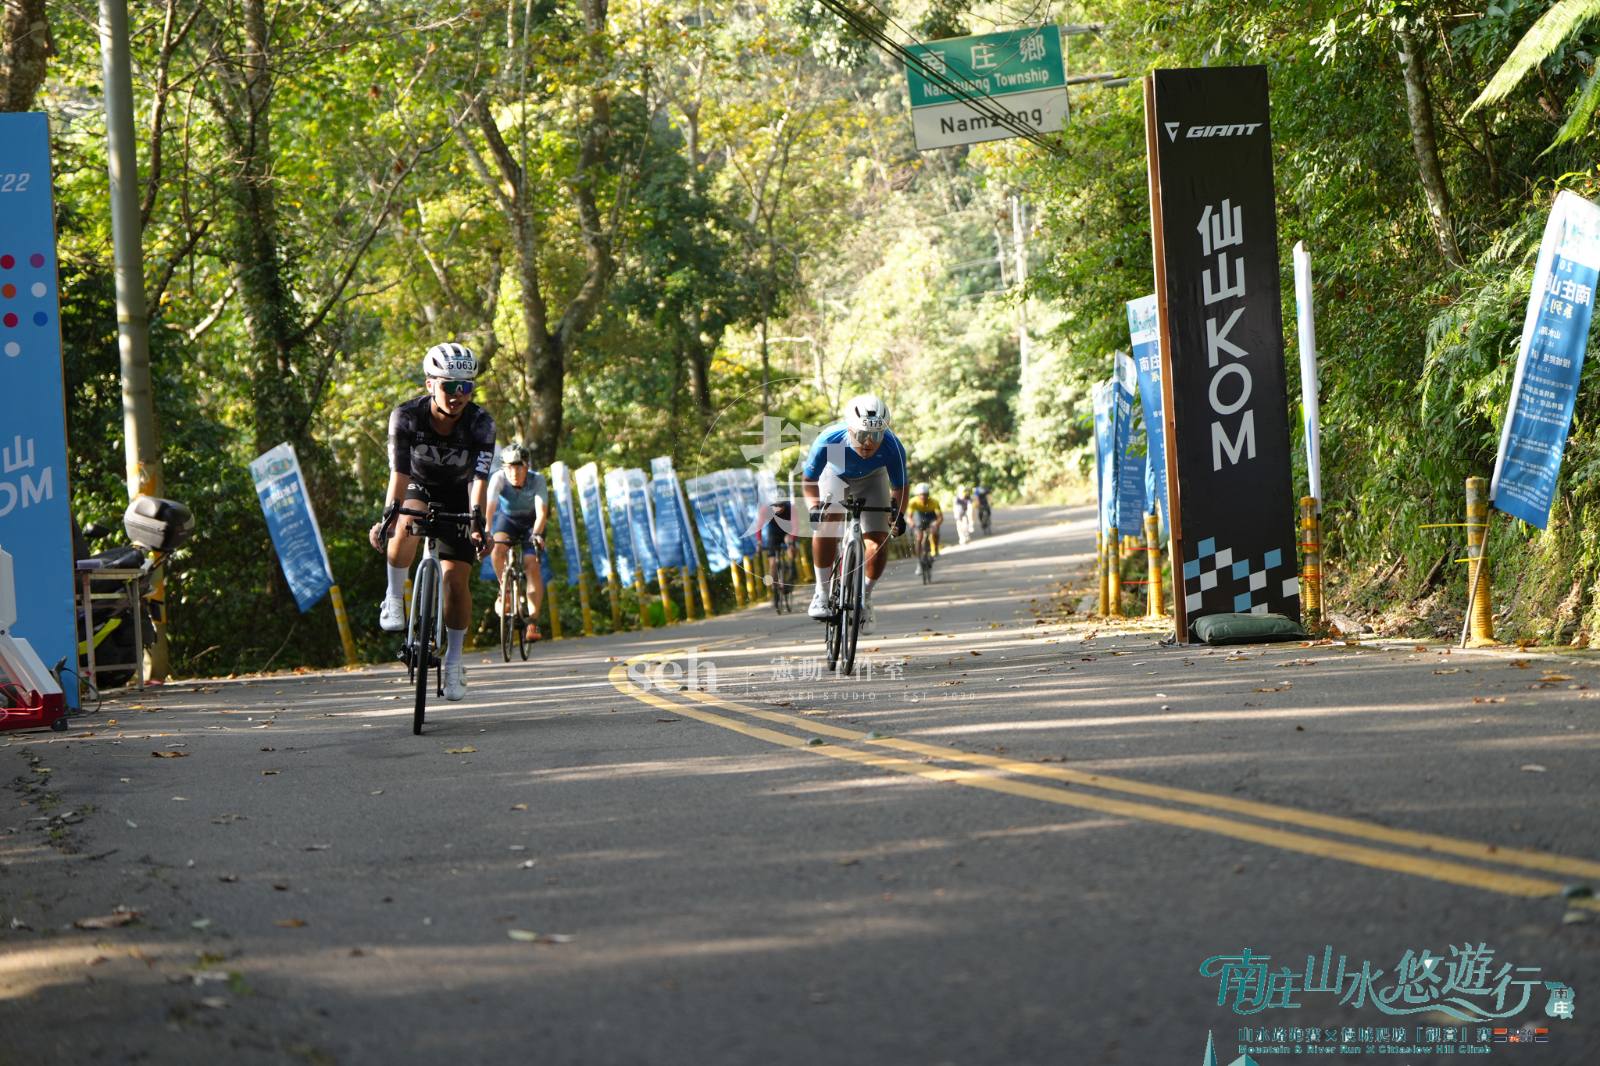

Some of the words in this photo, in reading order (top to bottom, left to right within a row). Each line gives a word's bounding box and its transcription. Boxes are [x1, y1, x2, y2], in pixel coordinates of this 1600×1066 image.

[919, 34, 1046, 76] 南庄鄉
[994, 68, 1049, 87] Township
[1186, 123, 1263, 138] GIANT
[0, 173, 30, 192] 22
[456, 361, 473, 370] 063
